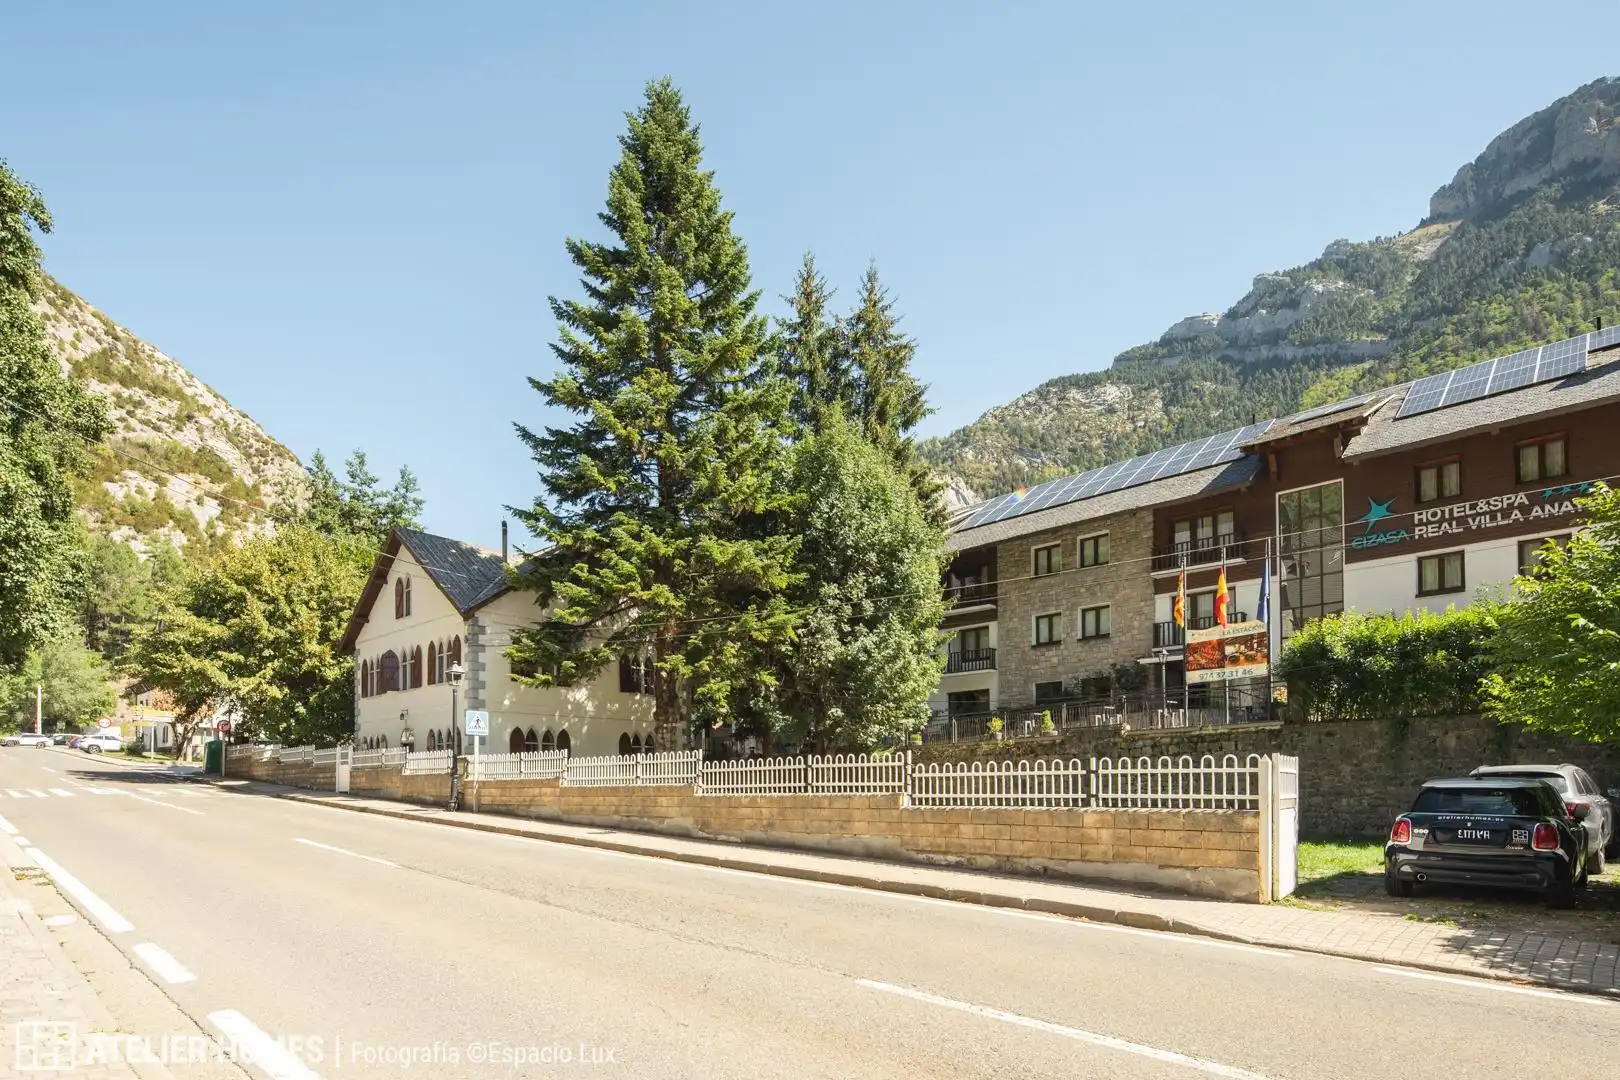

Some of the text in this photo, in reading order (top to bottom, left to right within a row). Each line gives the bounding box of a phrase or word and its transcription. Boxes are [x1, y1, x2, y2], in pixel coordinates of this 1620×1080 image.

[1413, 492, 1529, 525] HOTEL&SPA
[1414, 520, 1464, 540] REAL
[1467, 507, 1525, 531] VILLA
